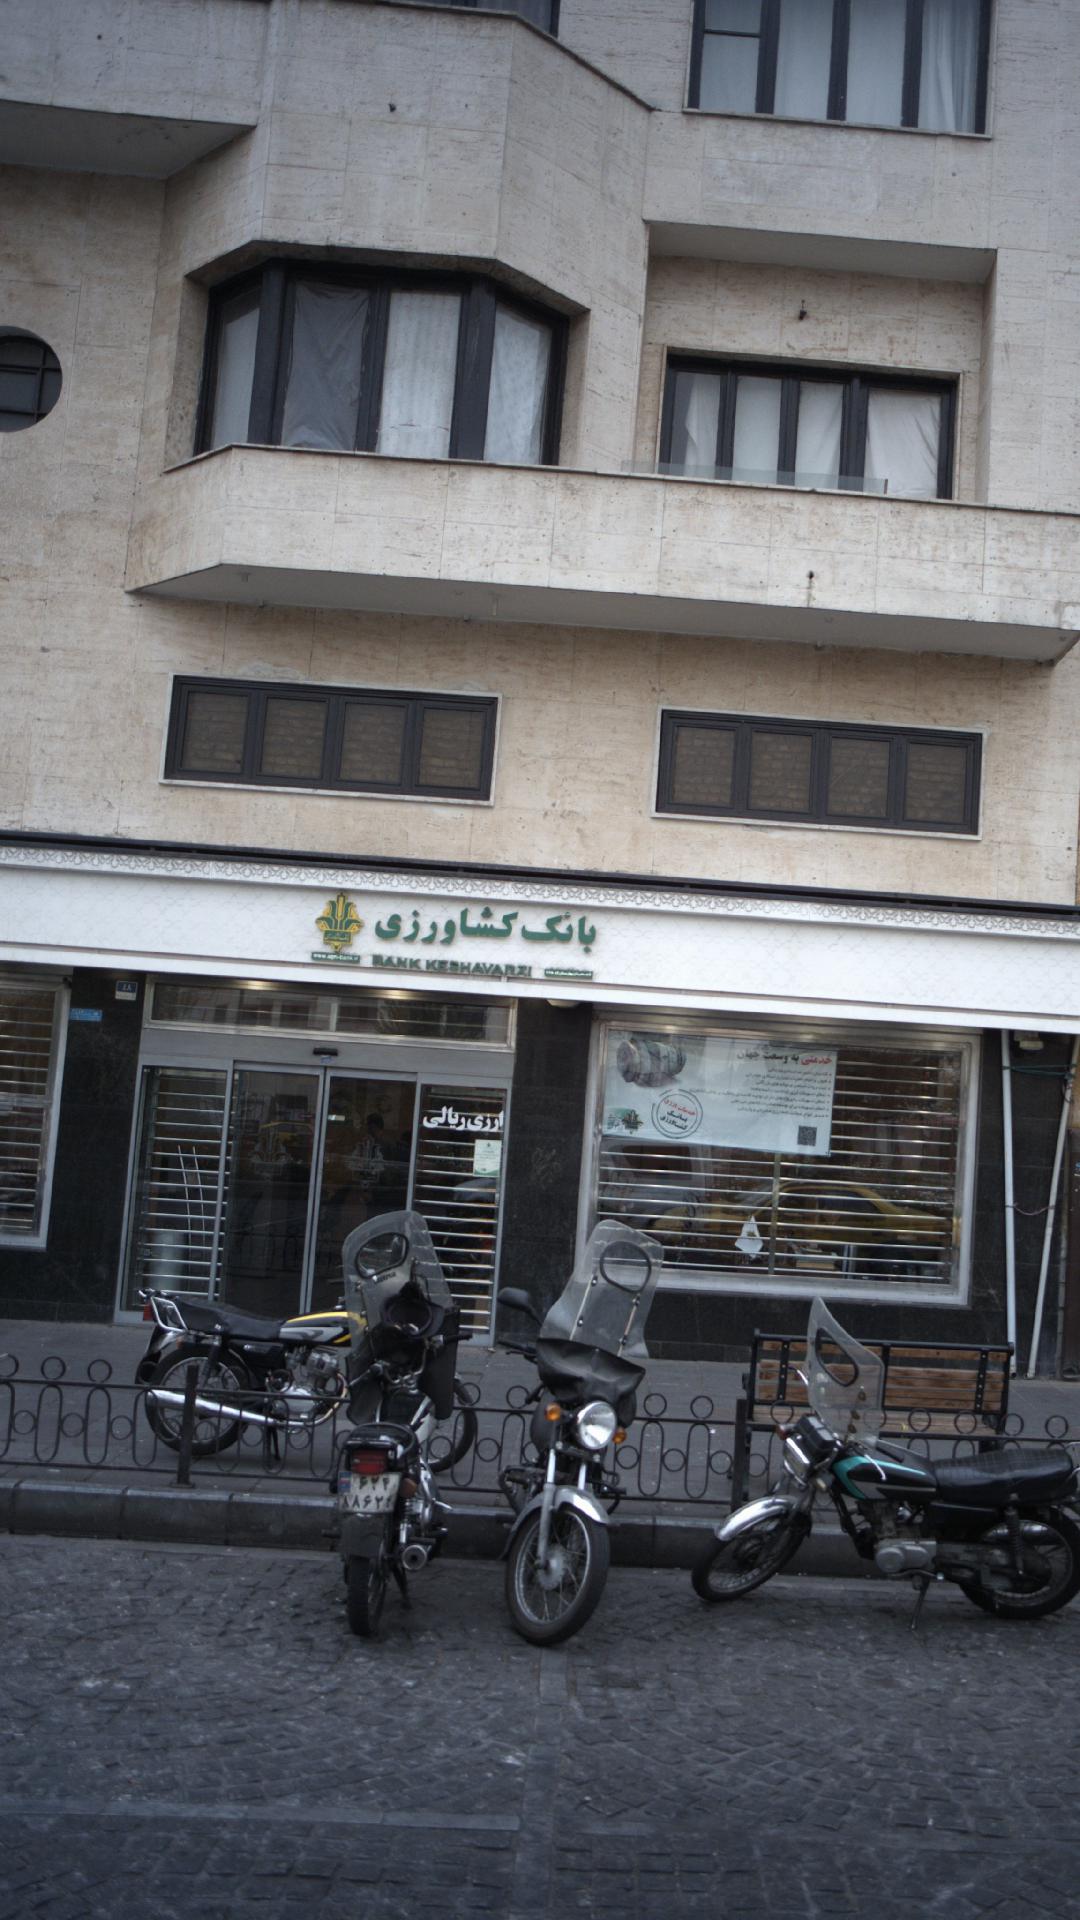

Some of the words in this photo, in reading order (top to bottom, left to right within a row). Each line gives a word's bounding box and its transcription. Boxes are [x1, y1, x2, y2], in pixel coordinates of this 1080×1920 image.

[374, 905, 519, 945] کشاورزی
[520, 910, 597, 954] بانک
[371, 953, 422, 971] BANK
[425, 959, 532, 978] KESHAVARZI
